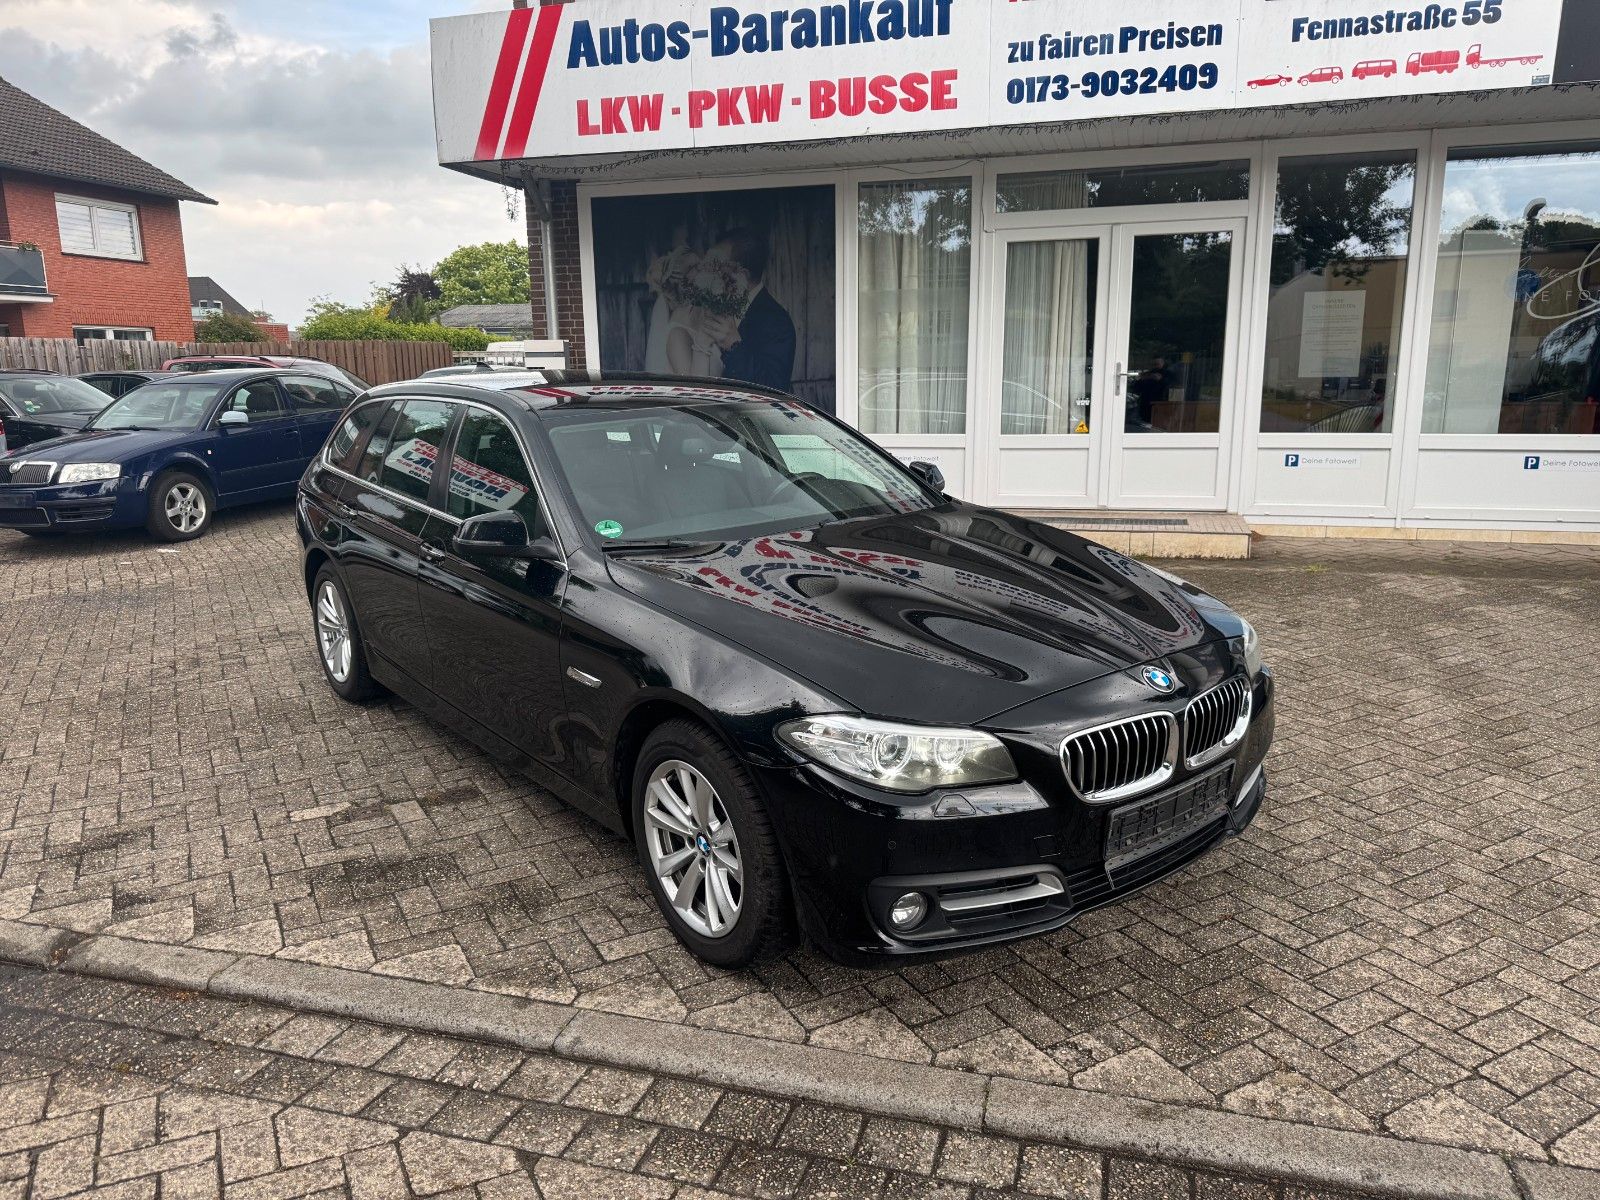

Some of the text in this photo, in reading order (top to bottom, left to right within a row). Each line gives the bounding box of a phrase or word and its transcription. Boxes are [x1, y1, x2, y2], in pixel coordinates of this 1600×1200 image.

[567, 0, 954, 69] Autos-Barankauf
[1007, 22, 1223, 63] zu fairen Preisen
[1291, 0, 1503, 42] Fennastraße 55
[577, 93, 664, 137] LKW
[688, 83, 784, 128] PKW
[809, 69, 959, 120] BUSSE
[1006, 62, 1219, 105] 0173-9032409
